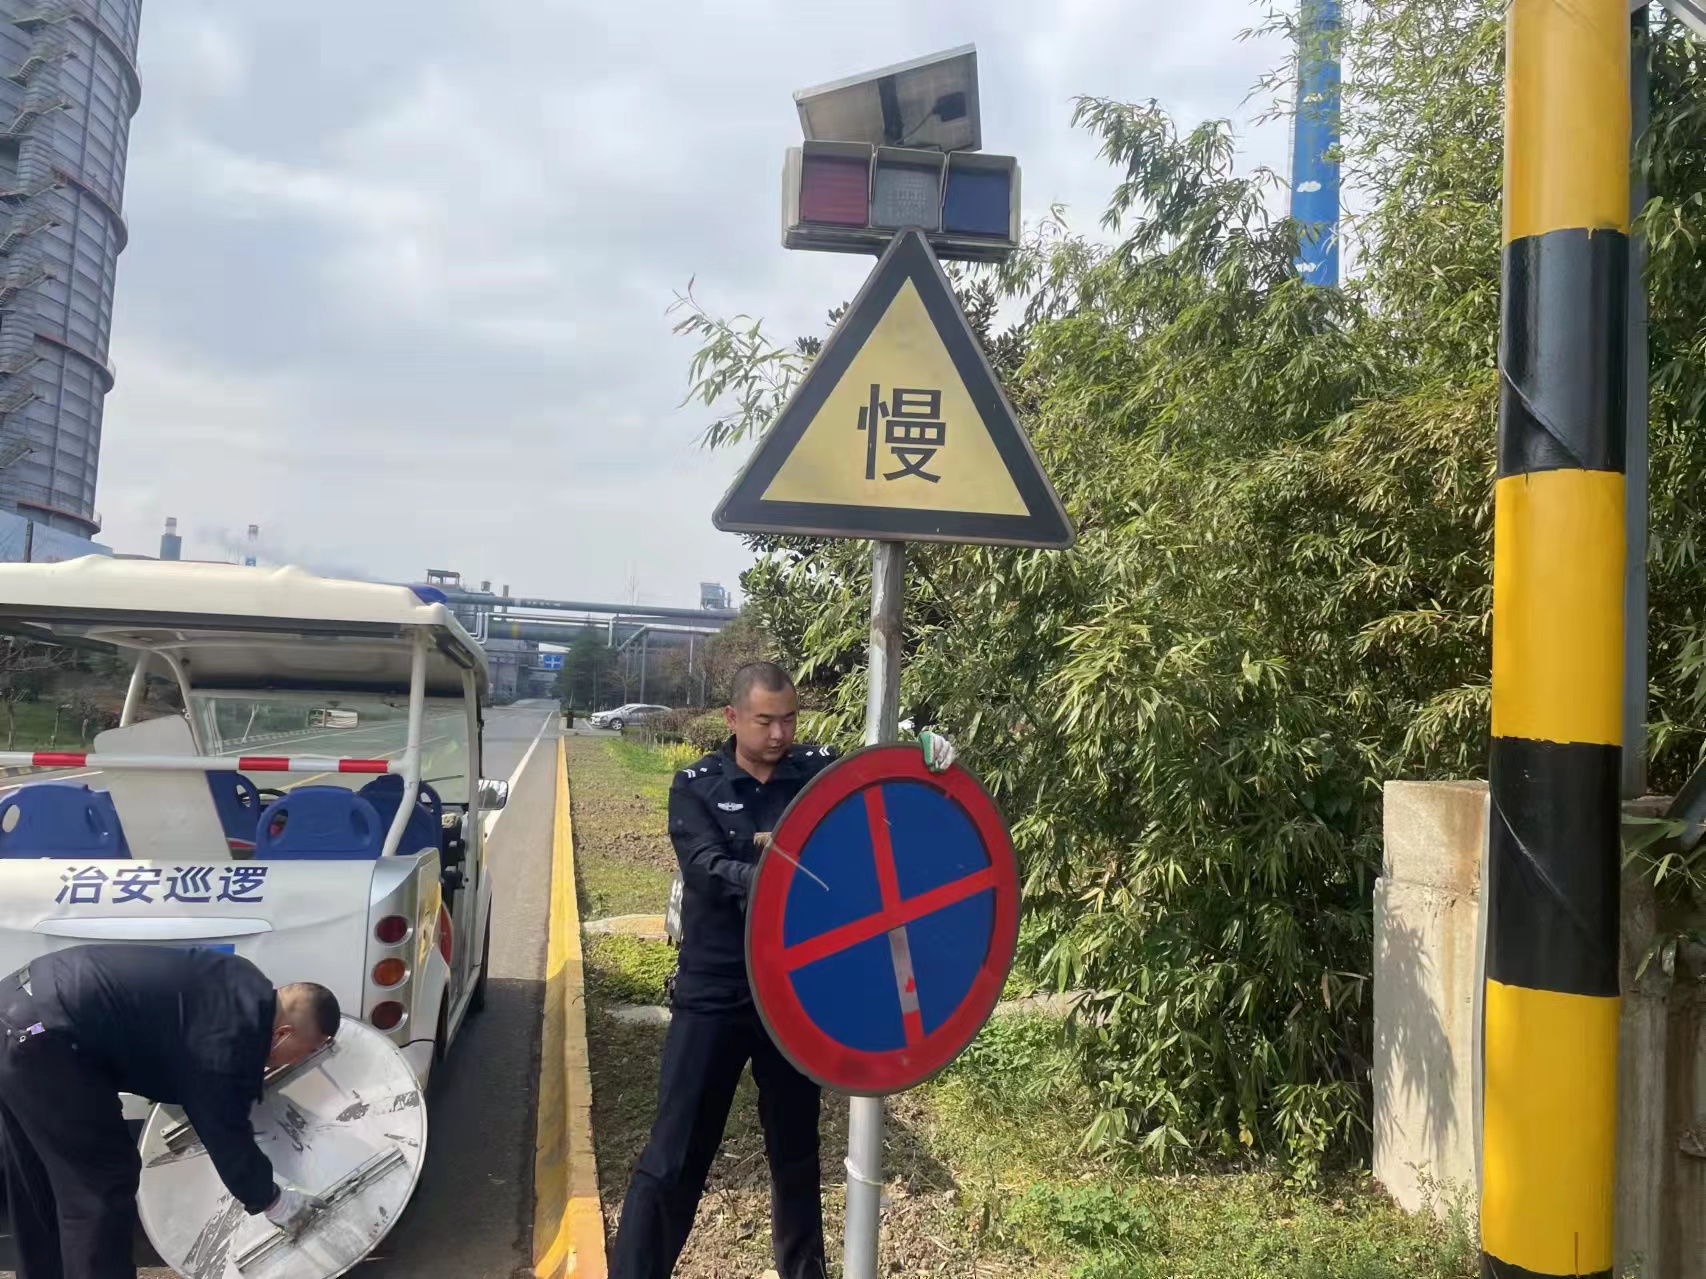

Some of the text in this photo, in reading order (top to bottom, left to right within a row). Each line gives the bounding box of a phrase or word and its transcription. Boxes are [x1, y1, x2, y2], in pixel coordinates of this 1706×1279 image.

[857, 383, 946, 483] 慢
[55, 866, 268, 904] 治安巡逻
